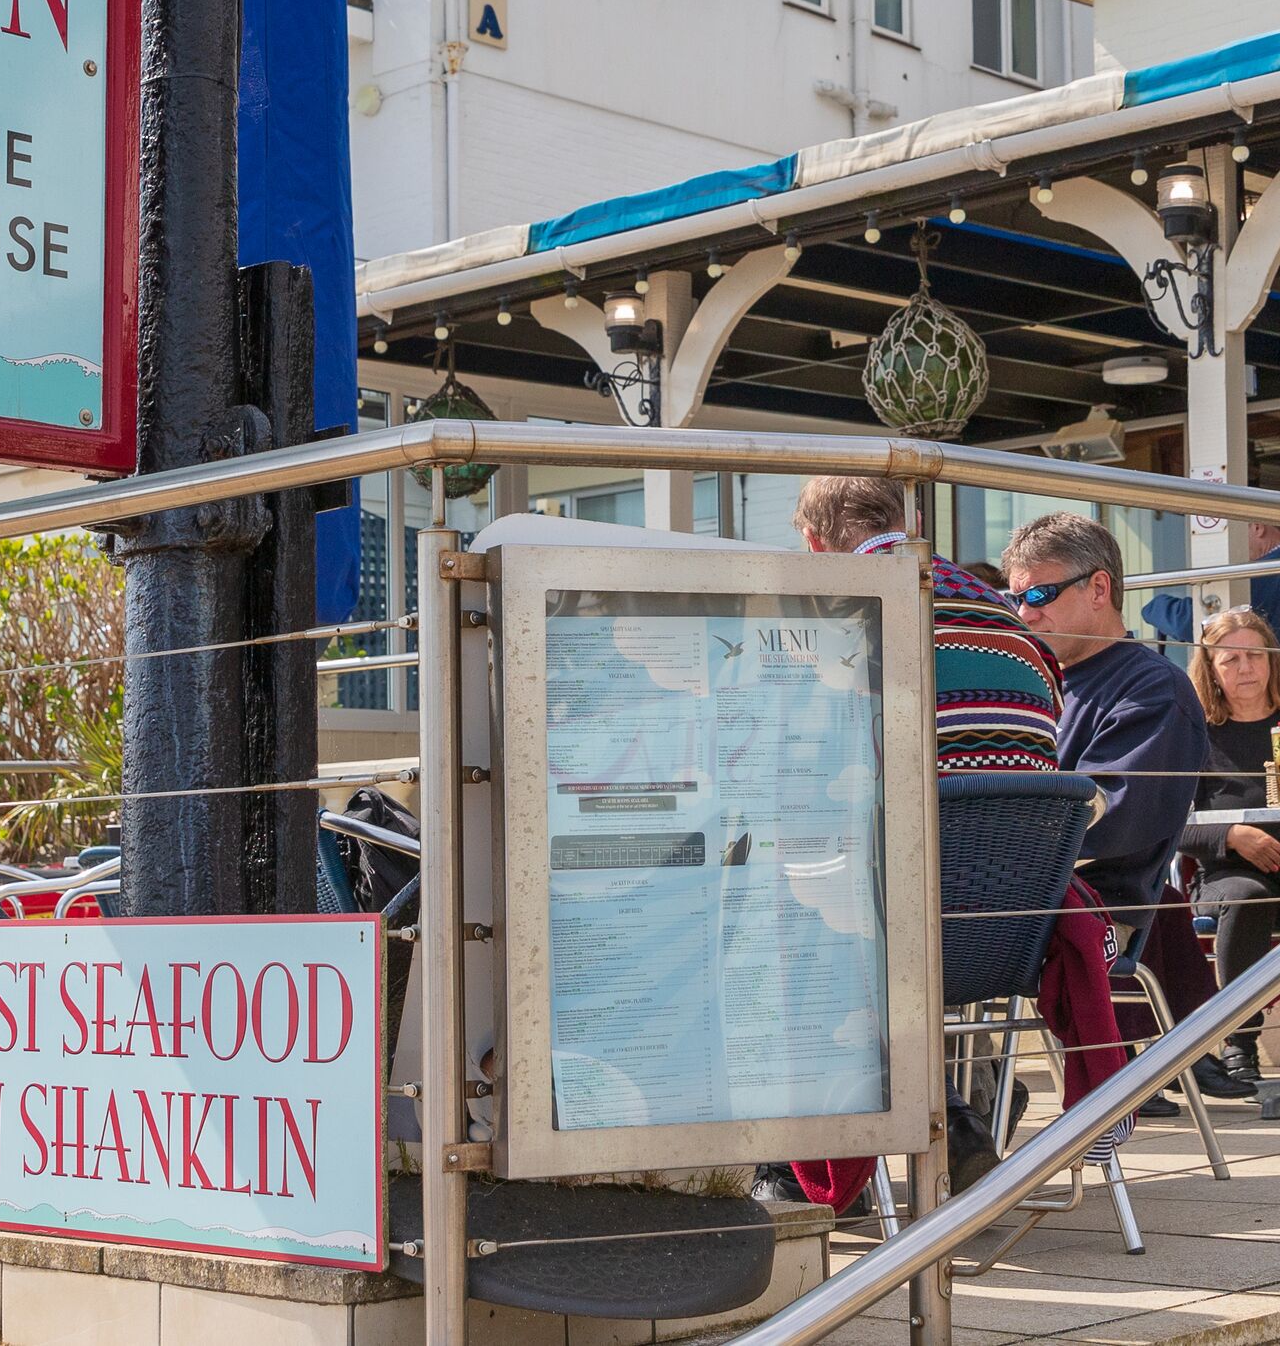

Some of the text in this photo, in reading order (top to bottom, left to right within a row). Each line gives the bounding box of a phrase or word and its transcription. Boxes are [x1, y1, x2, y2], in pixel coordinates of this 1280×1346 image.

[756, 628, 819, 652] MENU
[59, 960, 353, 1064] SEAFOOD
[19, 1082, 322, 1203] SHANKLIN
